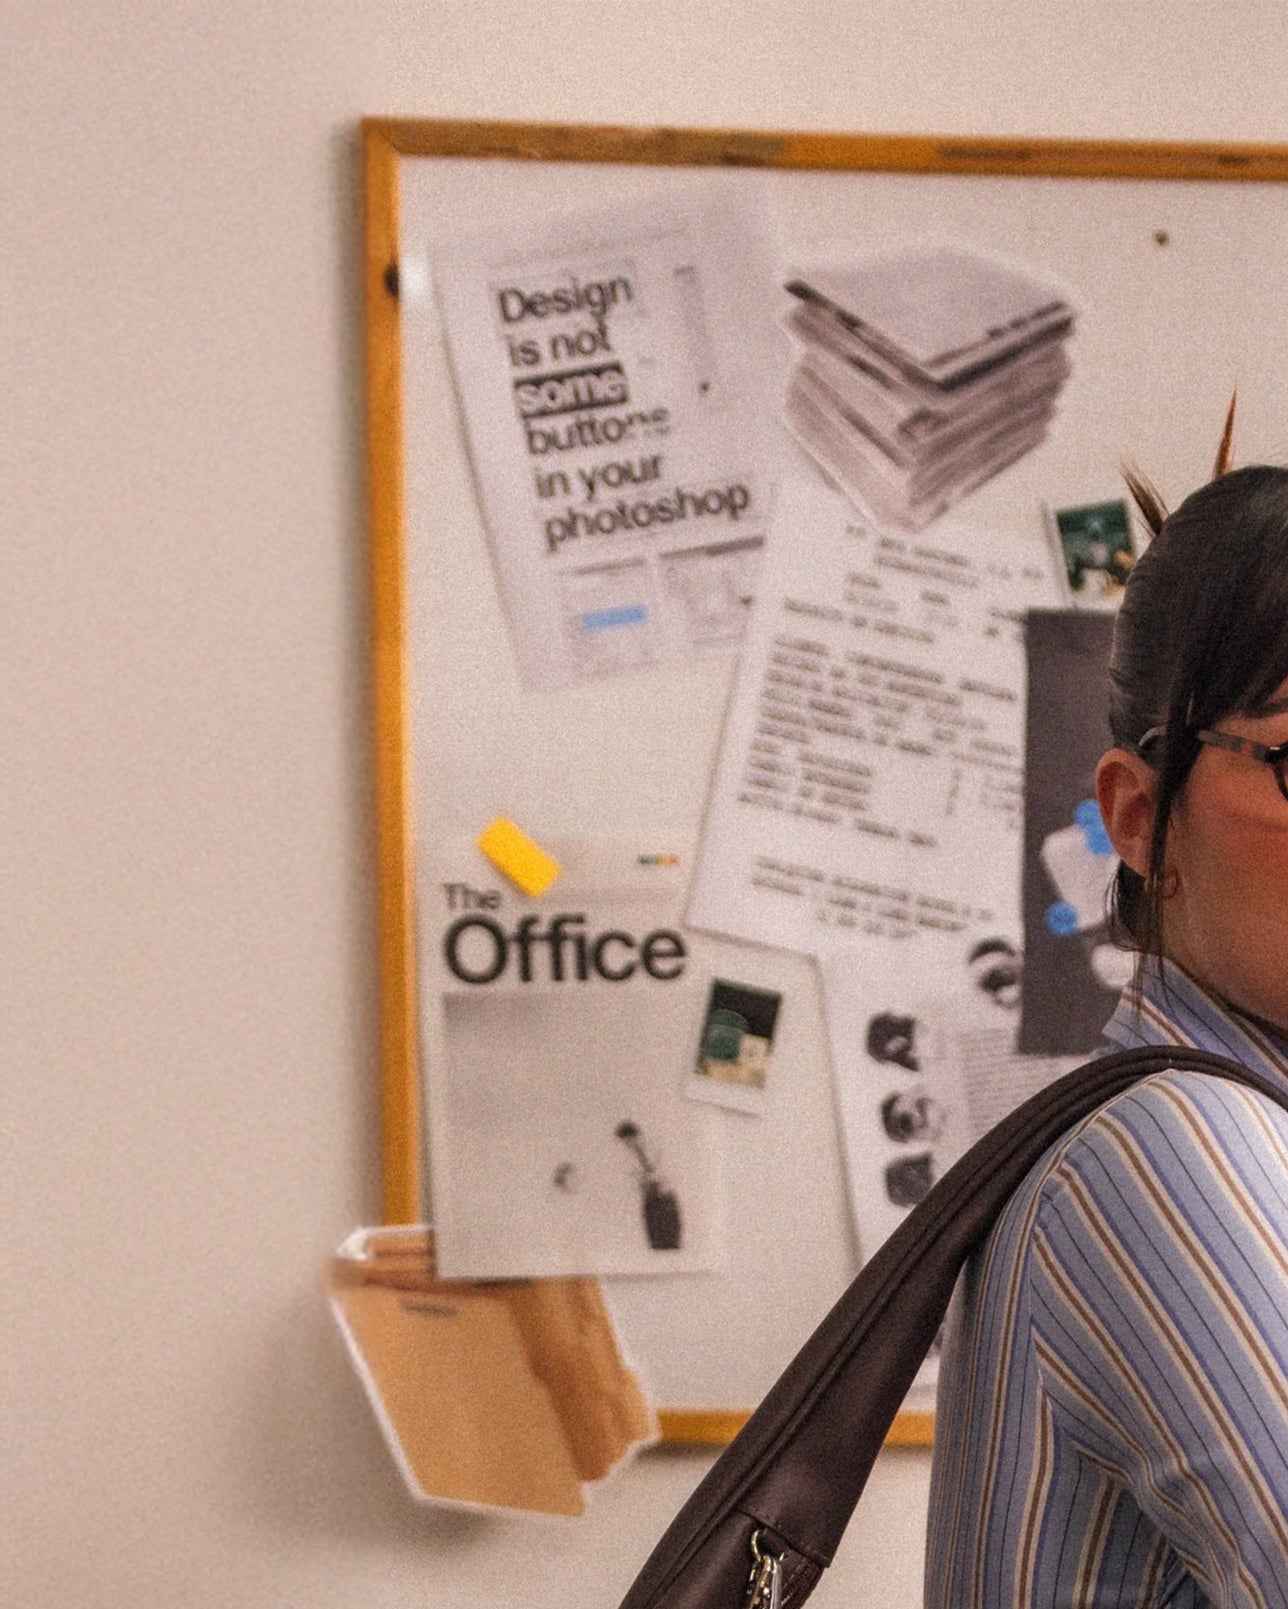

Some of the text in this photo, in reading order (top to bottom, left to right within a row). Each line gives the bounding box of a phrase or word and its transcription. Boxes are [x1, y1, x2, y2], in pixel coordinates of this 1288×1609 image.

[499, 277, 633, 322] Design
[507, 321, 612, 367] is not
[515, 368, 628, 413] some
[533, 456, 662, 501] in your
[545, 484, 749, 553] photoshop
[444, 912, 687, 985] Office
